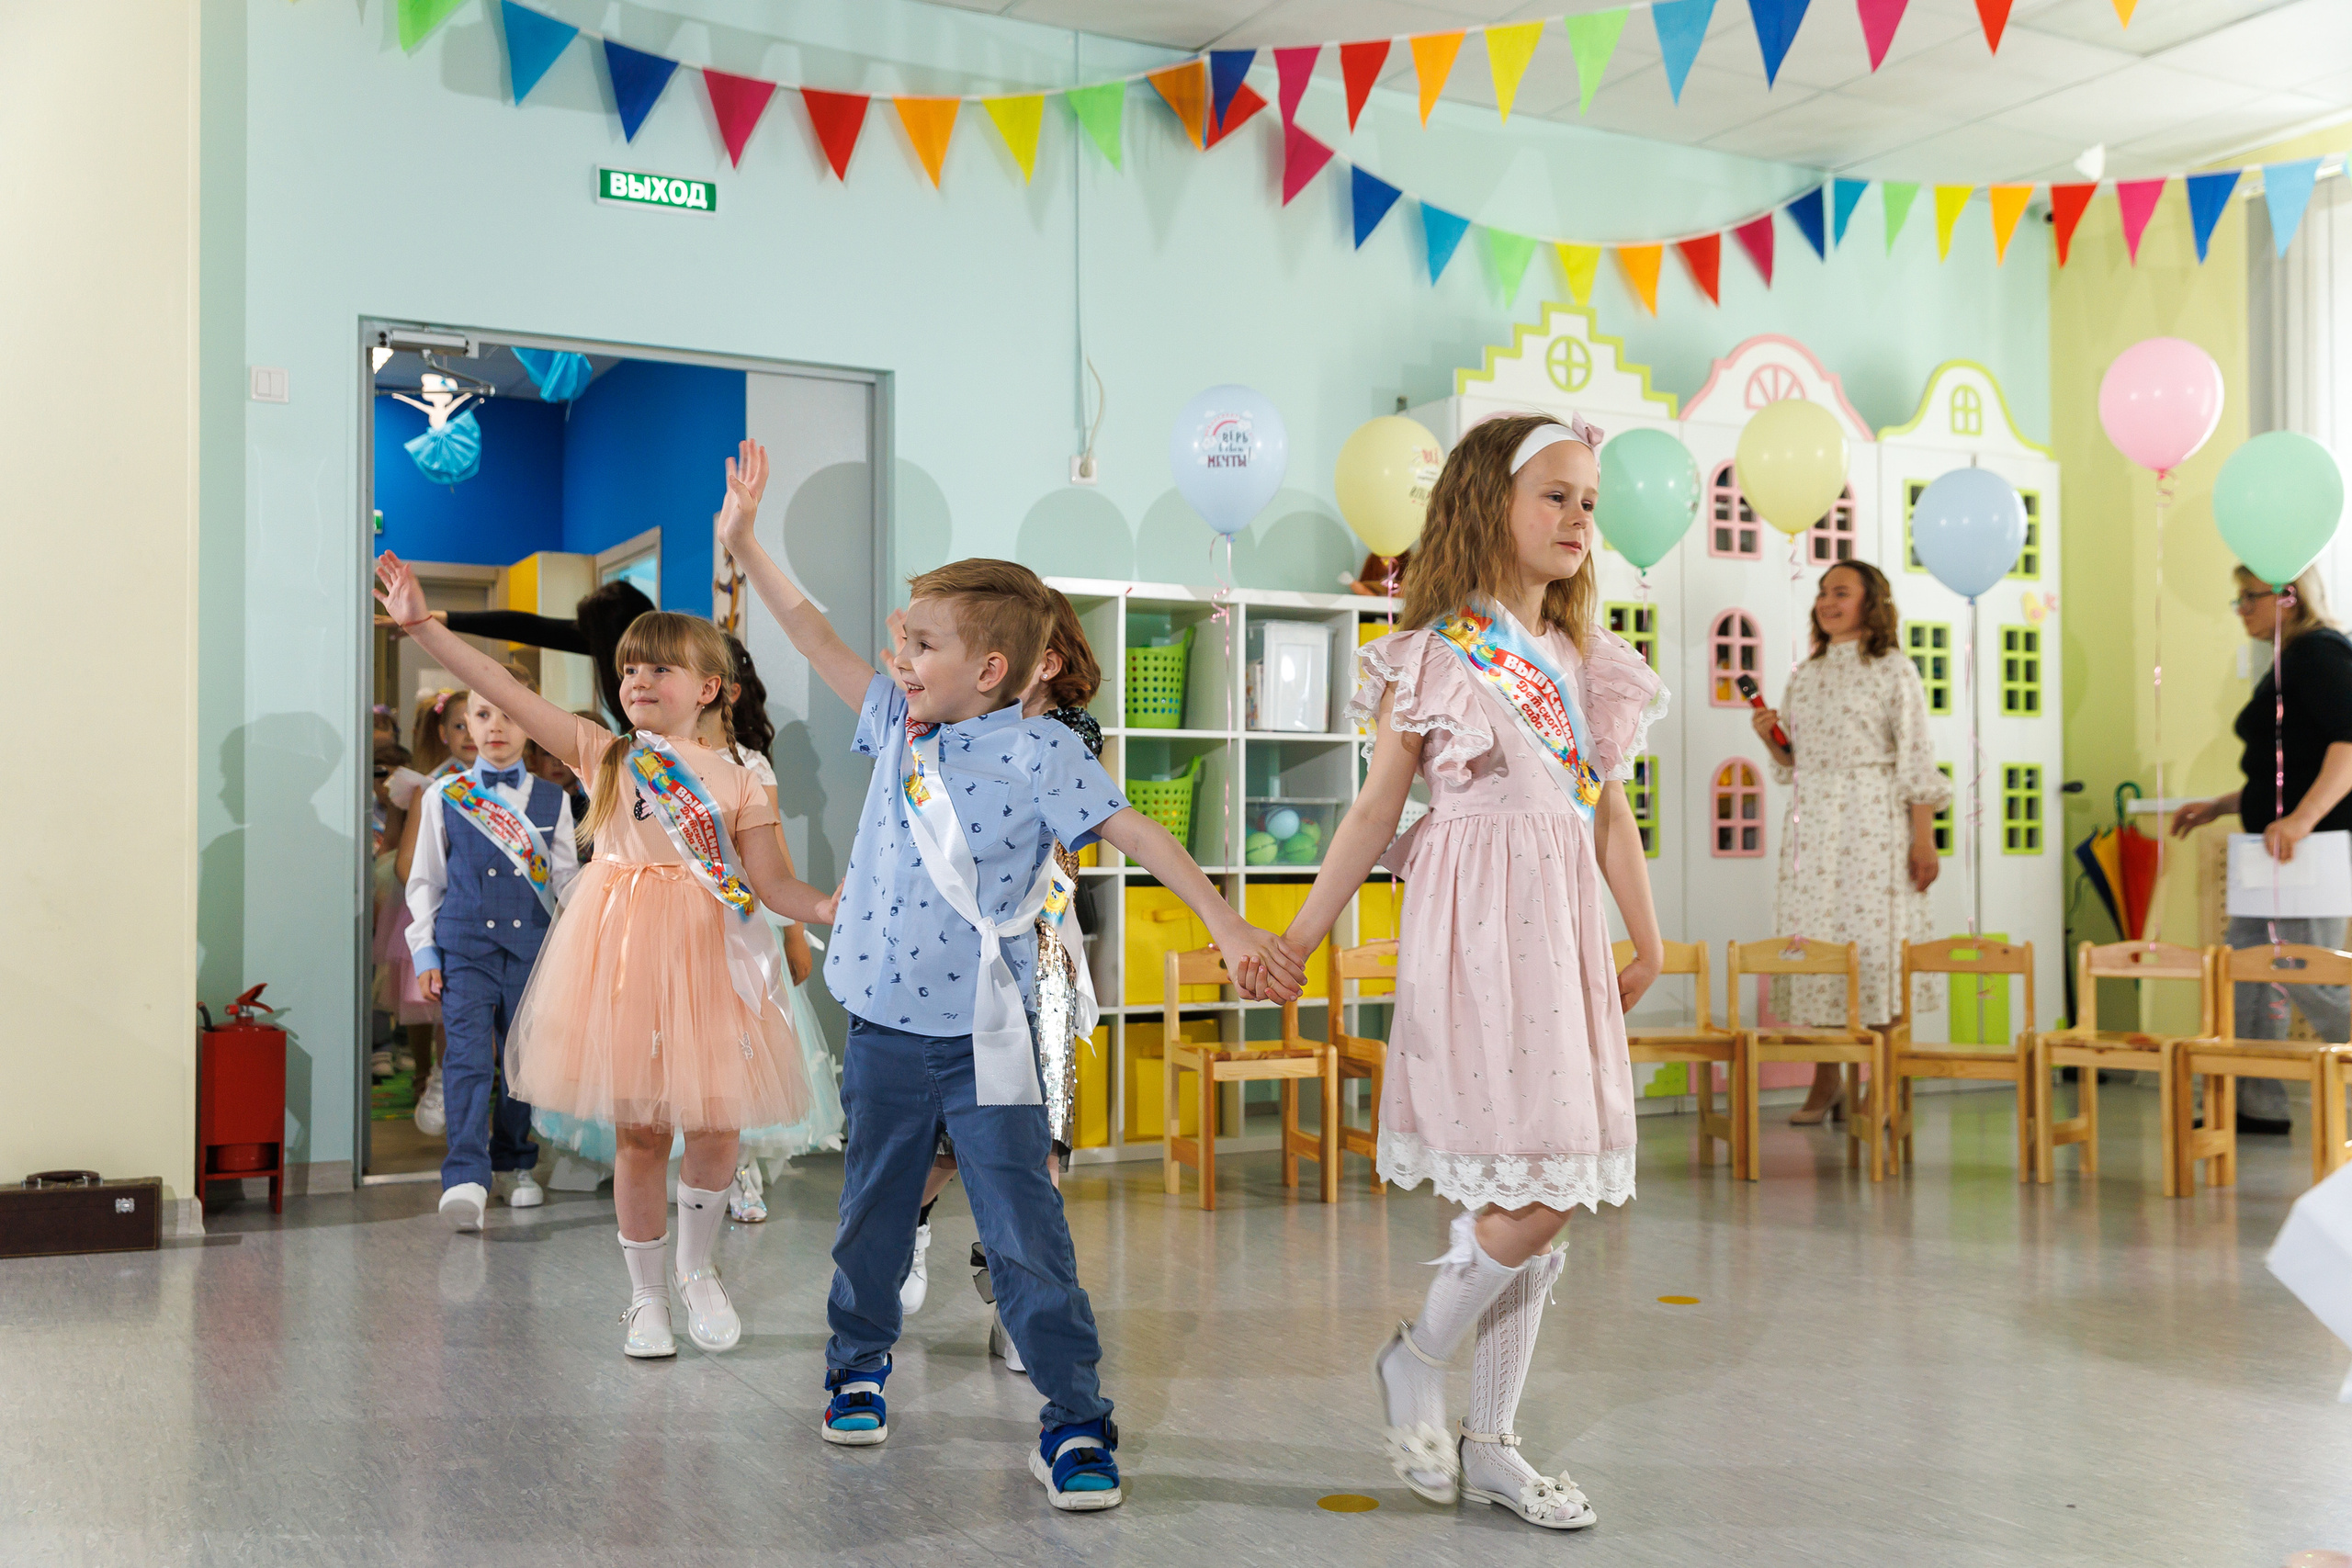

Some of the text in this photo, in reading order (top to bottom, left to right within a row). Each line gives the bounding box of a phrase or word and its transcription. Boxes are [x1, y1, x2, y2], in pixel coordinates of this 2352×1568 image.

[610, 172, 707, 209] ВЫХОД
[1502, 654, 1576, 751] ВЫПУСКНИК
[1516, 680, 1563, 737] Детского
[1521, 703, 1544, 730] сада
[674, 785, 723, 868] ВЫПУСКНИК
[679, 806, 708, 854] Детского
[679, 822, 695, 845] сада
